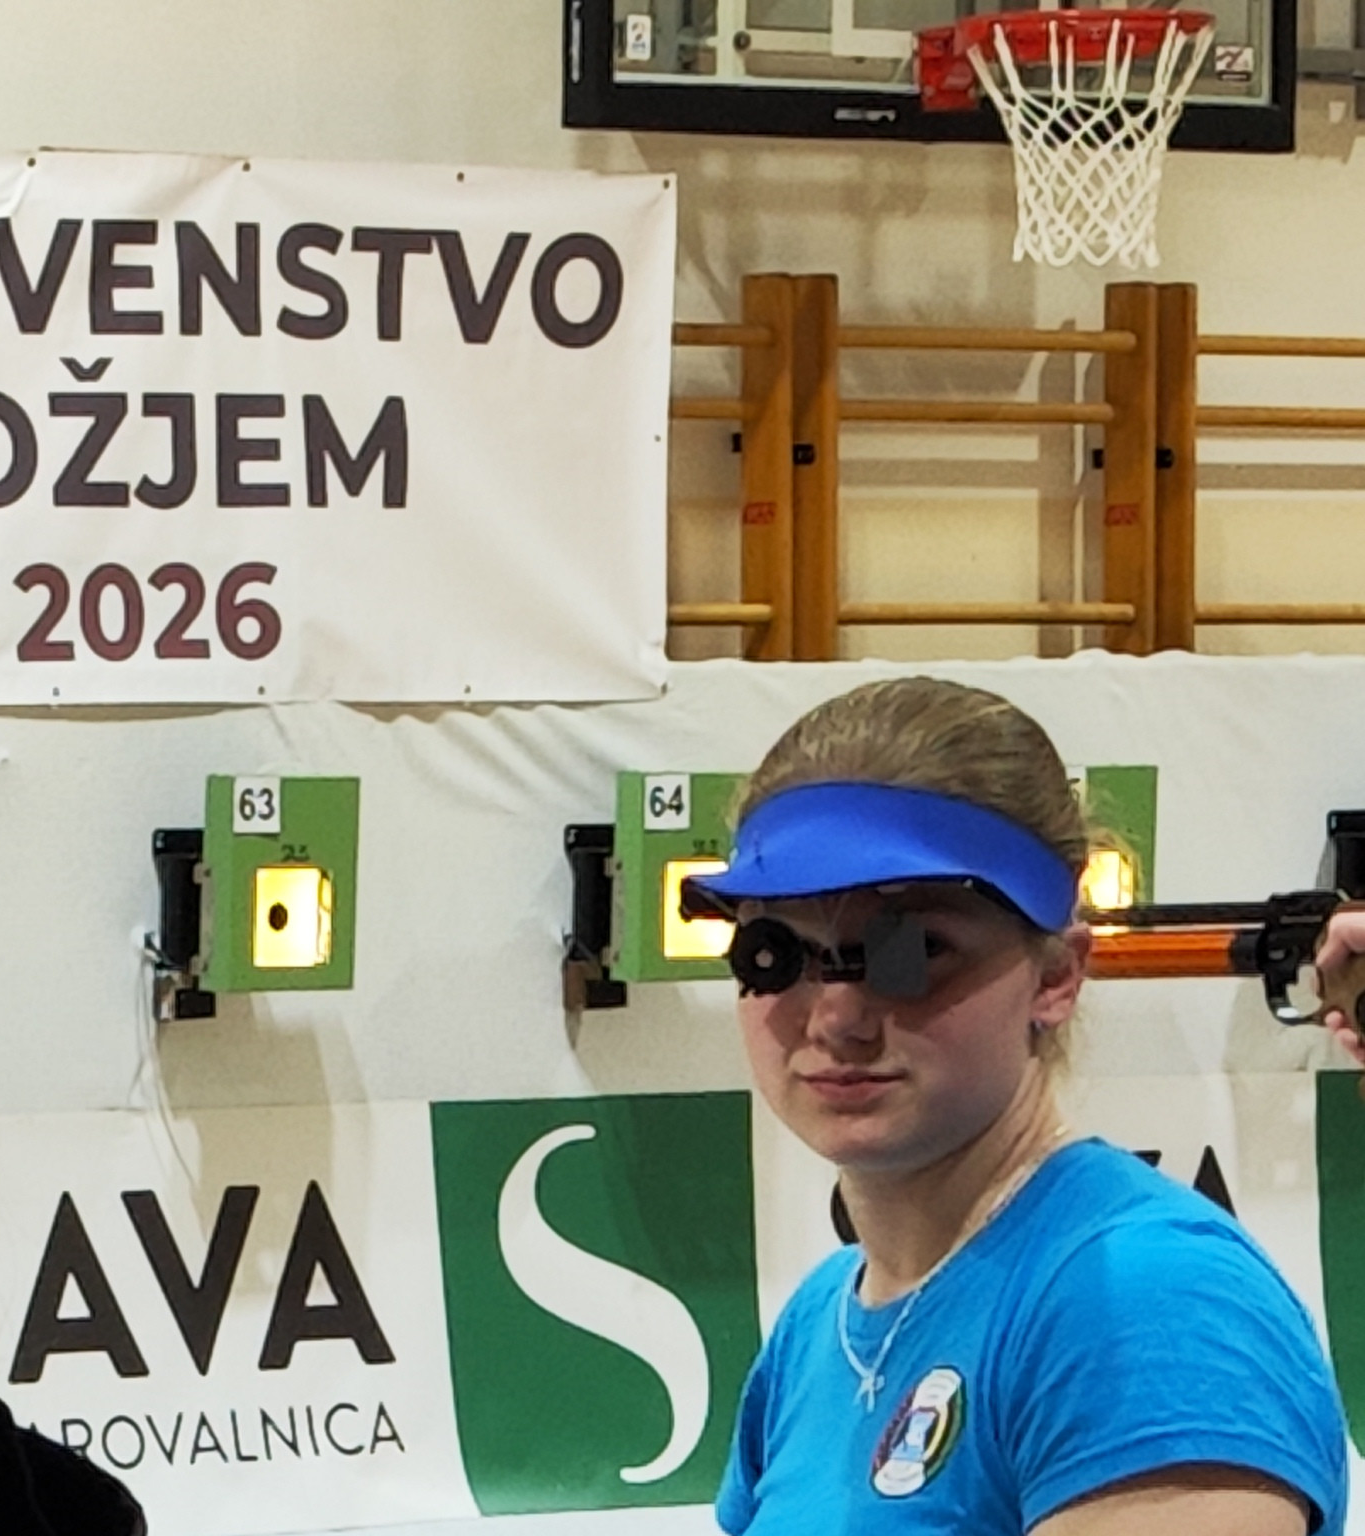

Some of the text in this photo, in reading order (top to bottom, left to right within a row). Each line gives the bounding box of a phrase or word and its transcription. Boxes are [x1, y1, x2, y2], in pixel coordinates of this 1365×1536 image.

[12, 560, 283, 662] 2026
[238, 787, 276, 821] 63
[649, 784, 685, 818] 64
[8, 1180, 397, 1384] AVA
[59, 1402, 407, 1471] ROVALNICA
